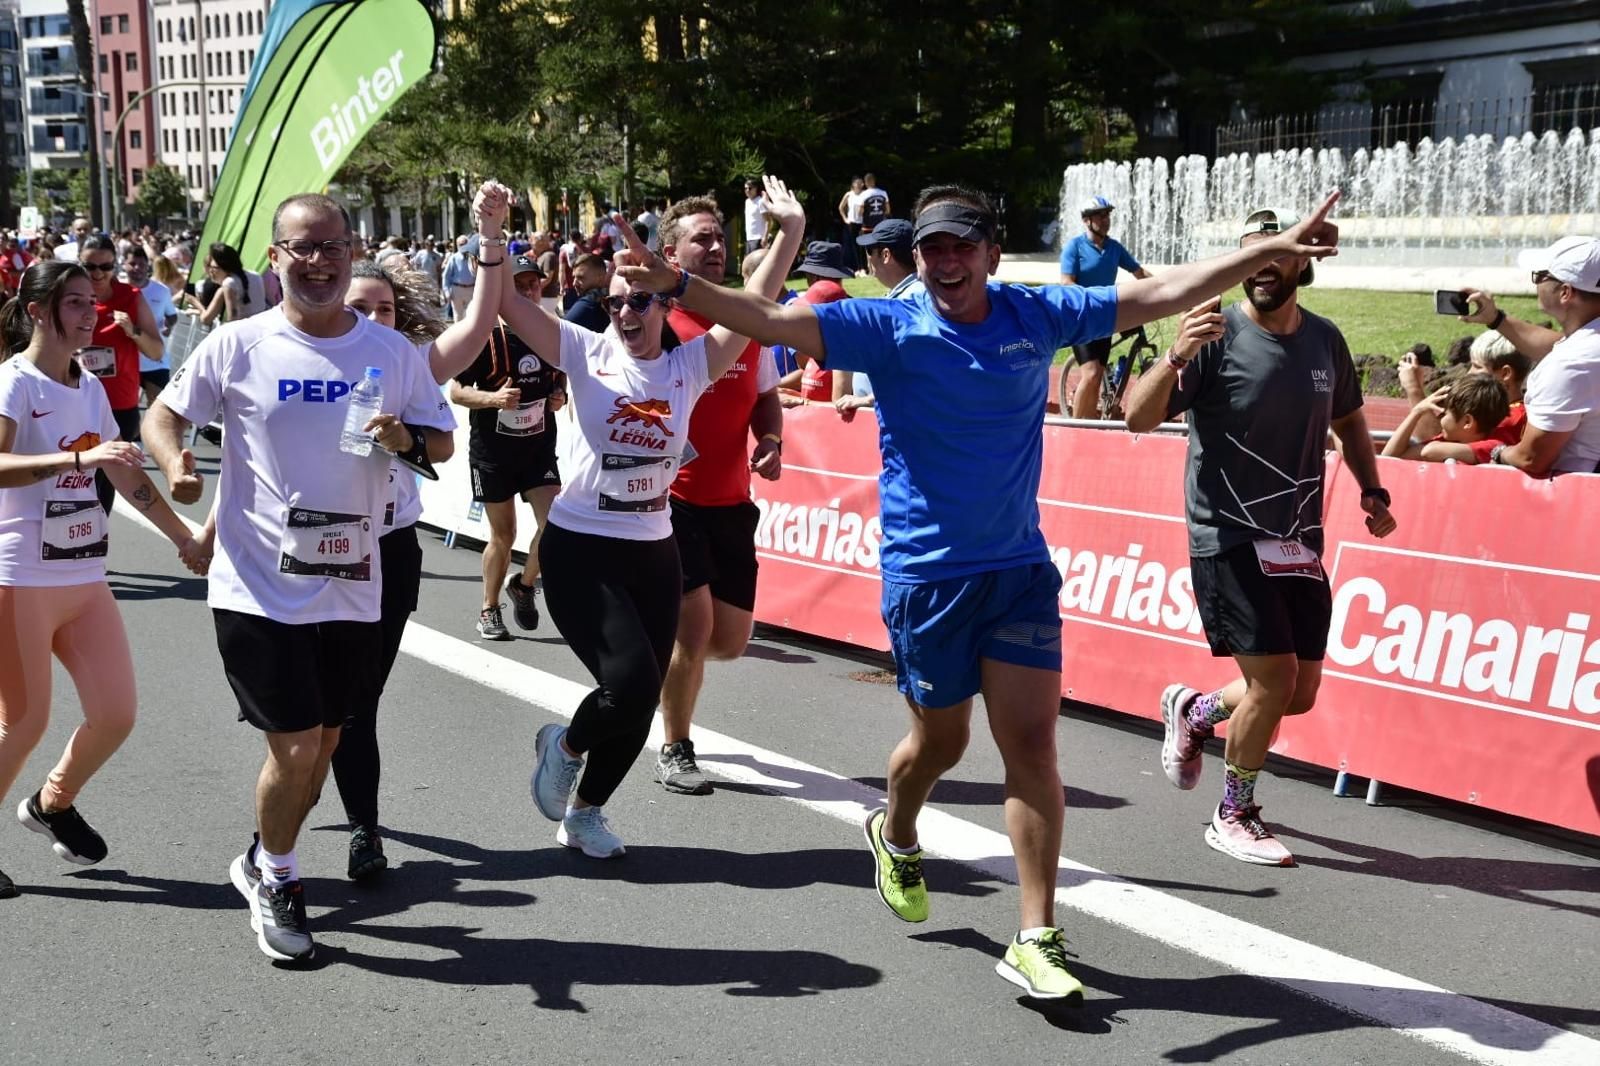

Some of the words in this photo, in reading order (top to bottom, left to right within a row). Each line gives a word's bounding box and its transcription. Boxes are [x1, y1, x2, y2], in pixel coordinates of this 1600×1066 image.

[309, 50, 404, 171] Binter
[278, 379, 359, 403] PEP
[609, 429, 668, 451] LEONA
[56, 474, 93, 489] LEONA
[627, 477, 653, 494] 5781
[68, 521, 91, 540] 5785
[748, 482, 881, 571] anarias
[317, 537, 350, 554] 4199
[1278, 543, 1302, 559] 1720
